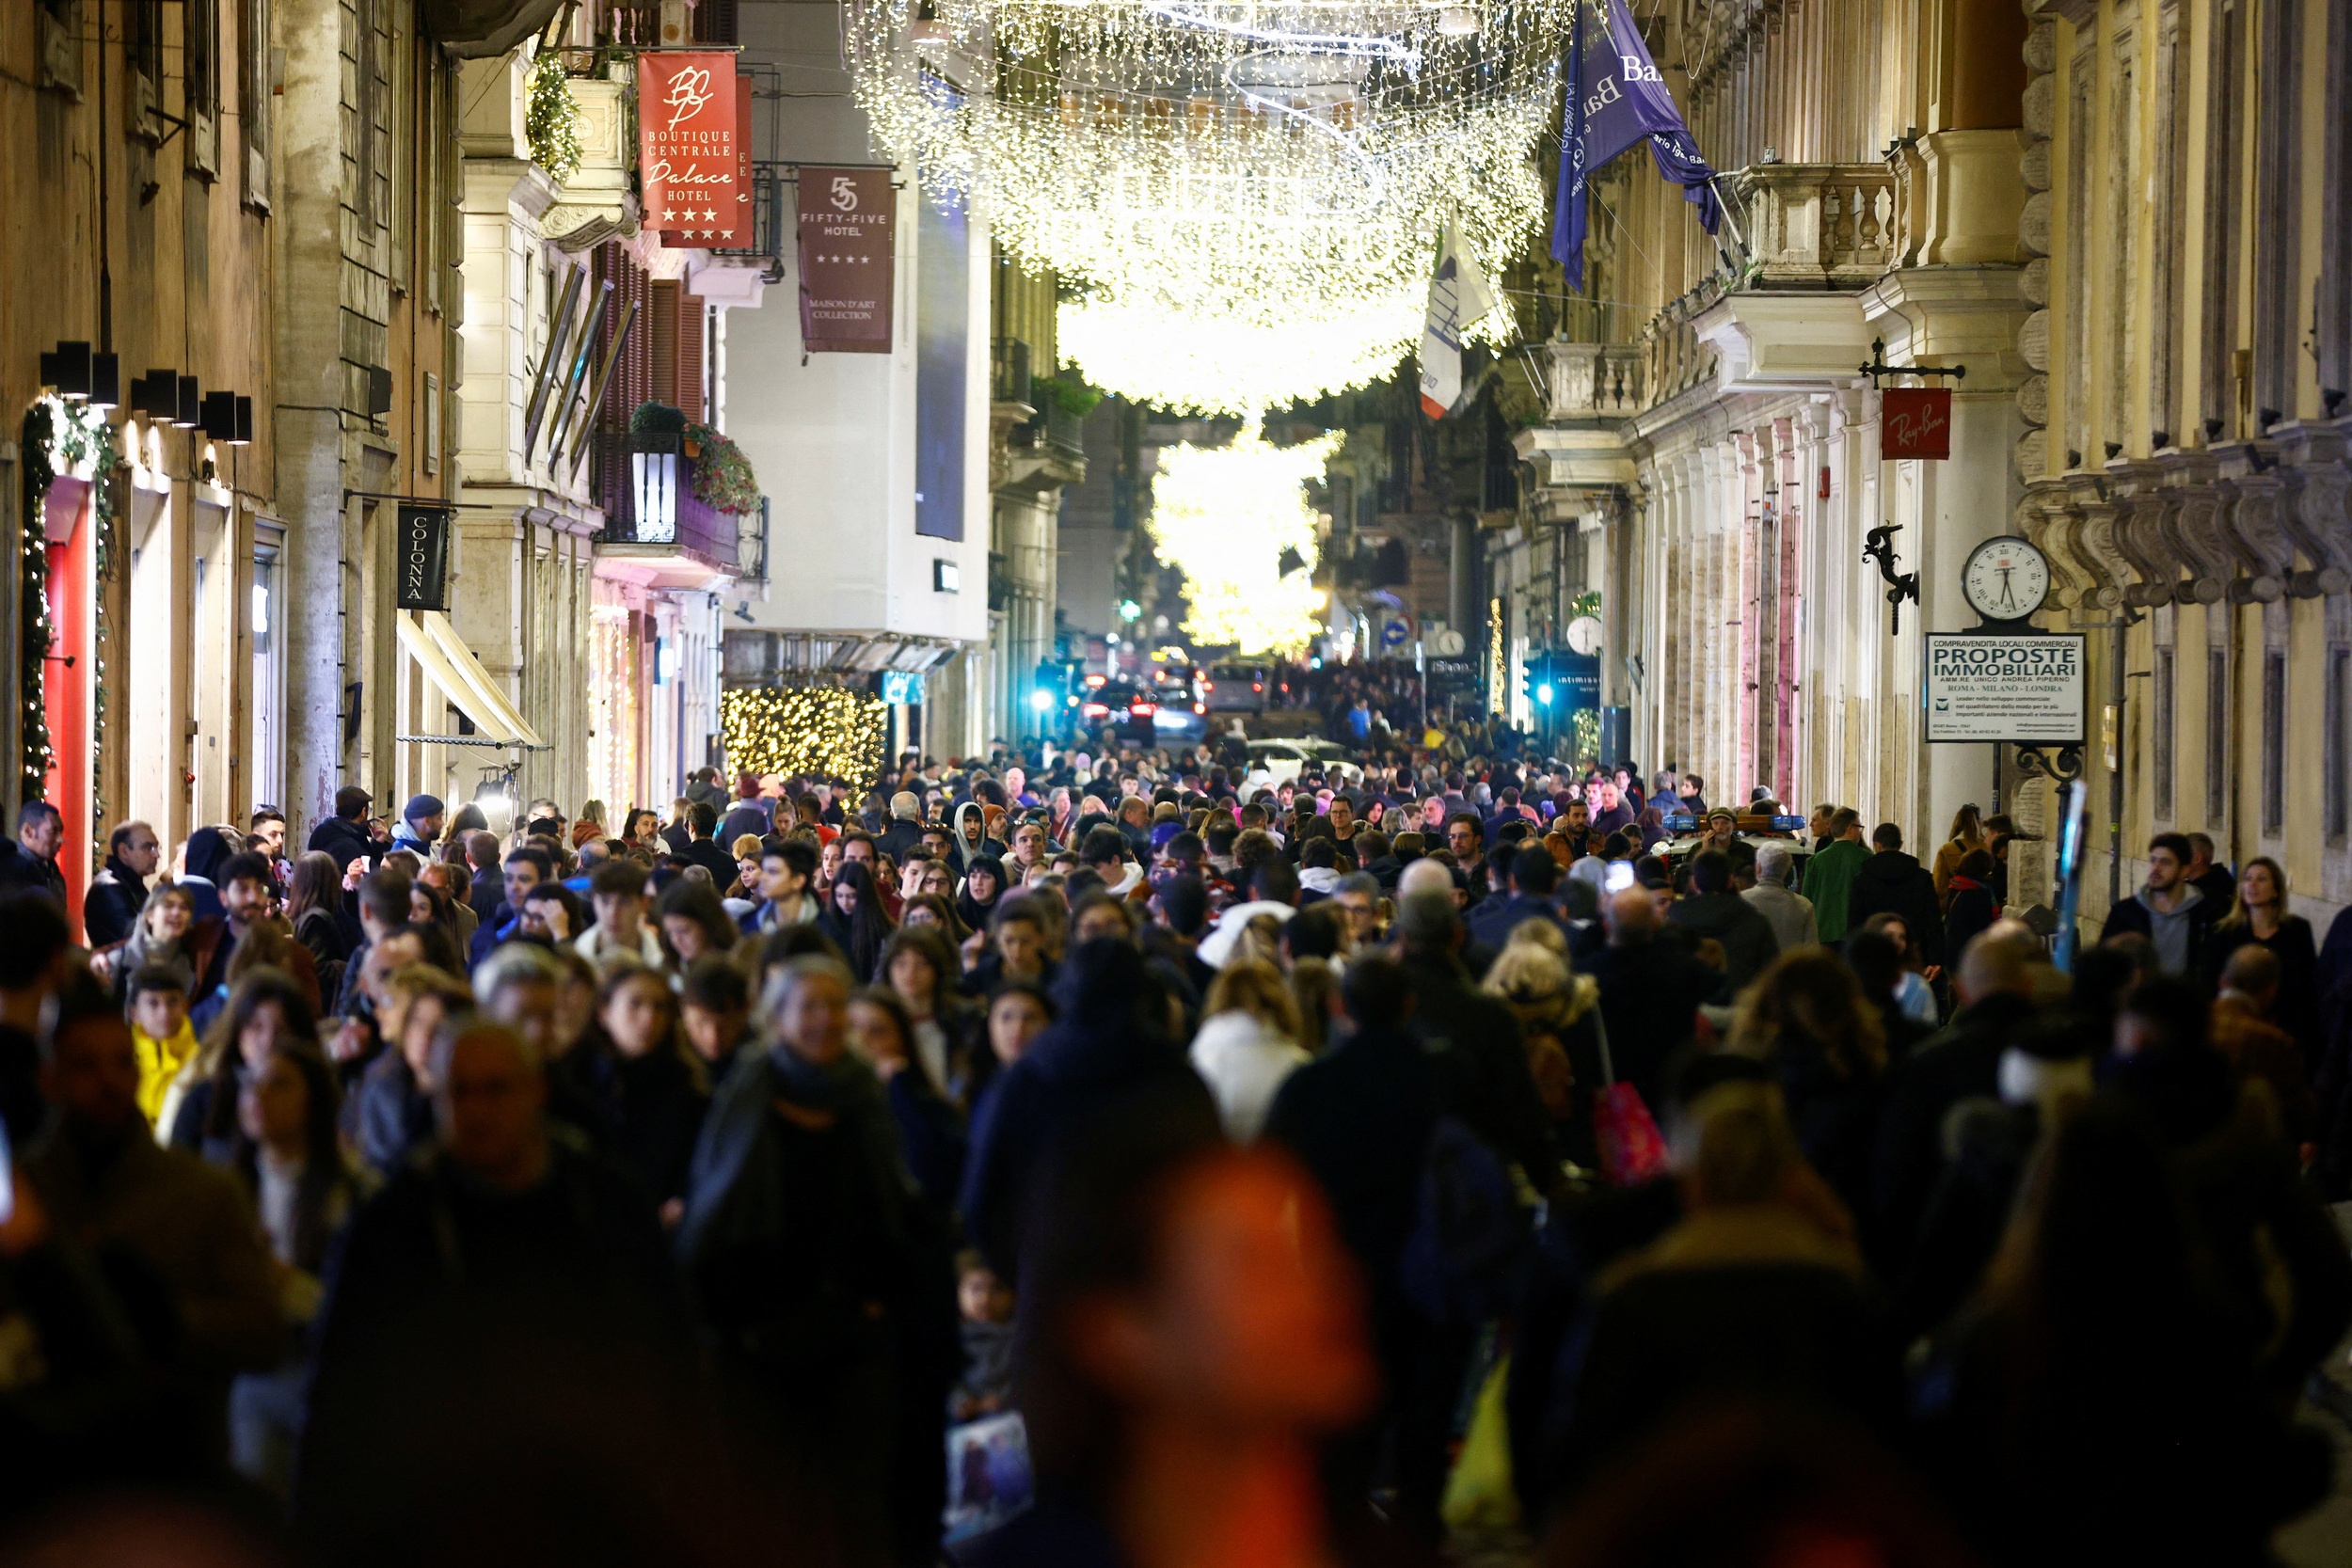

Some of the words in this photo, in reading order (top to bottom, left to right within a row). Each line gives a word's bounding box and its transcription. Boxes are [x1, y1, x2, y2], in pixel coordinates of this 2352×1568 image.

[648, 131, 730, 144] BOUTIQUE
[648, 146, 731, 156] CENTRALE
[645, 158, 733, 190] Palace
[667, 191, 711, 201] HOTEL
[801, 213, 886, 224] FIFTY-FIVE
[824, 227, 863, 236] HOTEL
[809, 299, 847, 309] MAISON
[848, 300, 876, 309] D'ART
[812, 310, 872, 320] COLLECTION
[407, 516, 427, 600] COLONNA
[1934, 648, 2075, 663] PROPOSTE
[1934, 664, 2075, 675] IMMOBILIARI
